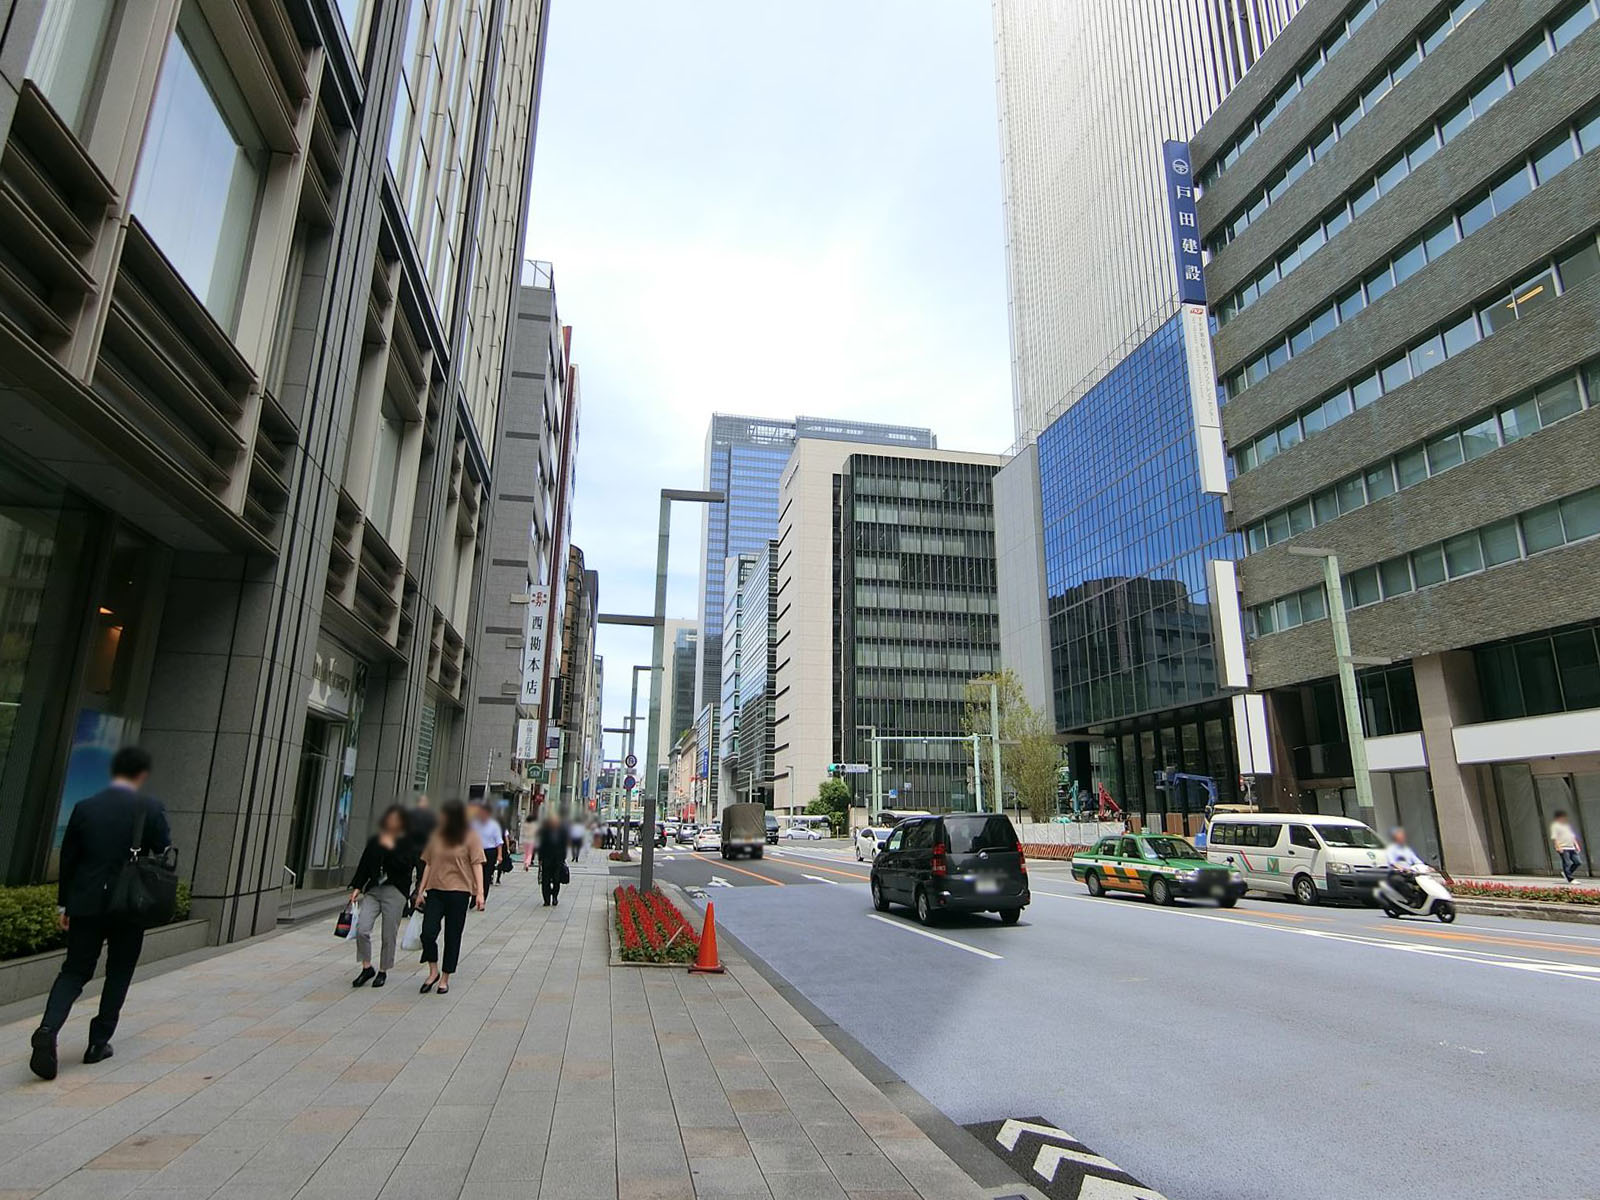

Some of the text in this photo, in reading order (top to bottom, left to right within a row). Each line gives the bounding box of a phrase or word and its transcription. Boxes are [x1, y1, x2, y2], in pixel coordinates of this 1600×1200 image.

[1176, 185, 1201, 281] 戸田建設
[526, 615, 543, 695] 西勘本店
